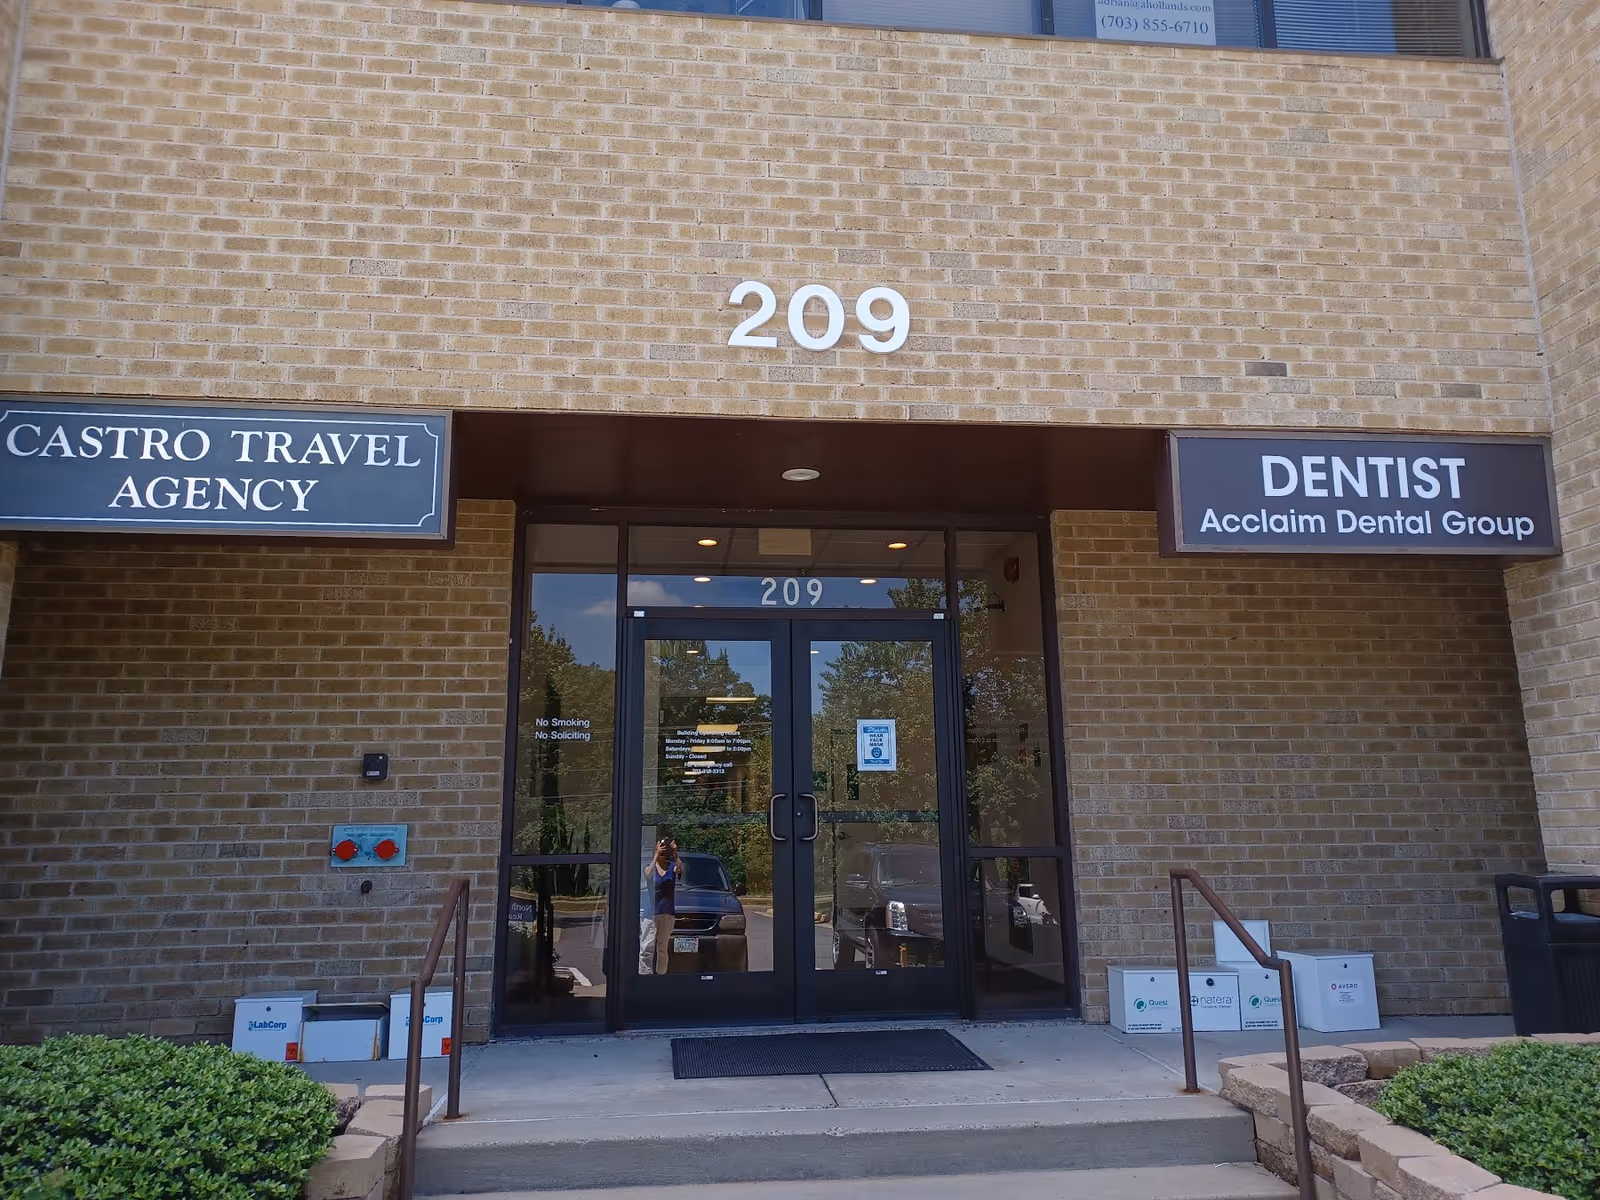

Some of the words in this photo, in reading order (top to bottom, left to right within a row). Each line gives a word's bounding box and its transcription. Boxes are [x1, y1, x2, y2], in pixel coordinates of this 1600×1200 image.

[1101, 15, 1138, 32] (703)
[1143, 18, 1209, 35] 855-6710
[727, 280, 910, 353] 209
[6, 423, 210, 461] CASTRO
[230, 430, 422, 468] TRAVEL
[1261, 455, 1466, 499] DENTIST
[108, 475, 319, 512] AGENCY
[1200, 508, 1326, 534] Acclaim
[1336, 508, 1432, 535] Dental
[1442, 510, 1535, 541] Group
[761, 577, 823, 606] 209
[535, 718, 549, 727] No
[551, 717, 590, 729] Smoking
[676, 729, 699, 737] Building
[535, 731, 548, 740] No
[551, 731, 591, 742] Soliciting
[1200, 996, 1232, 1004] natera
[1263, 995, 1281, 1003] Ques
[253, 1020, 288, 1030] LabCorp
